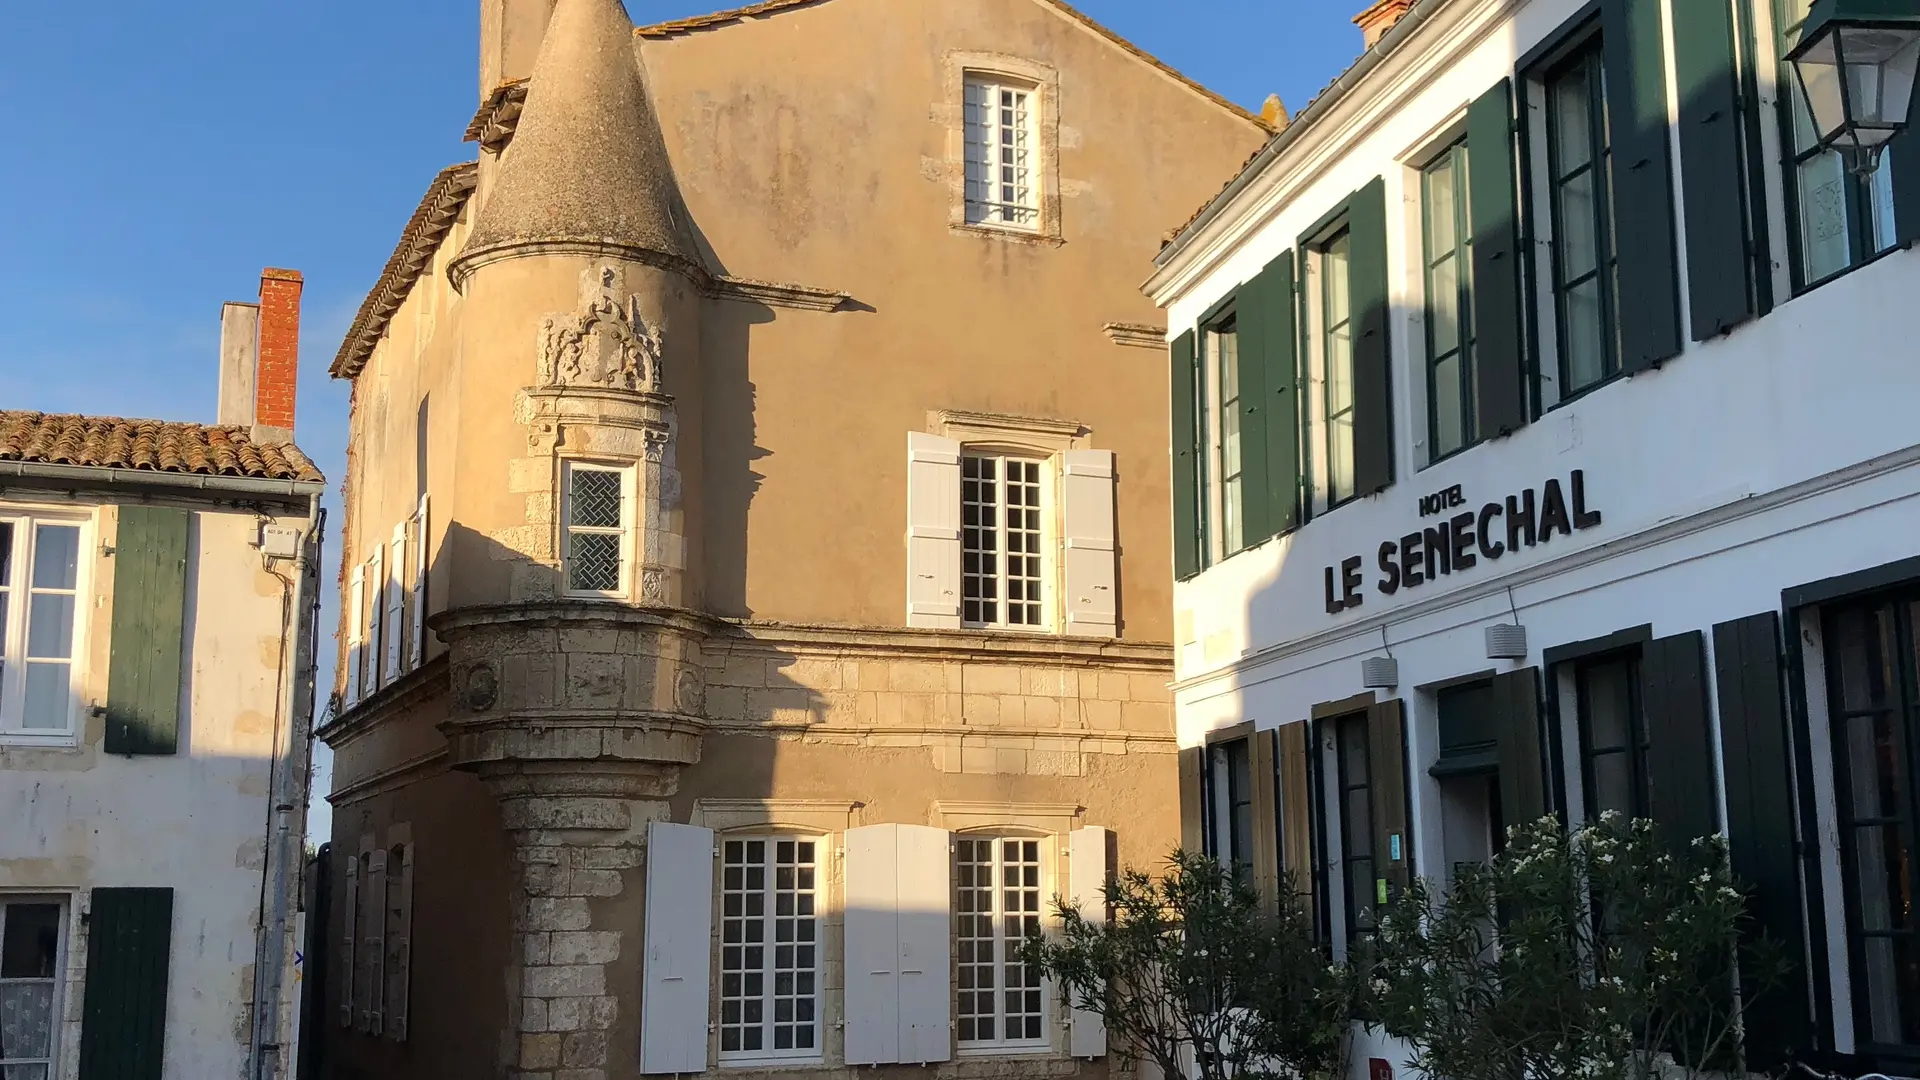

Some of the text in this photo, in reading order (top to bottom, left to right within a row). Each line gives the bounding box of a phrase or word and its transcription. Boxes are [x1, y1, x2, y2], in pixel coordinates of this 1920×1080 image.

[1325, 469, 1601, 614] LE SENECHAL
[1419, 484, 1466, 517] HOTEL
